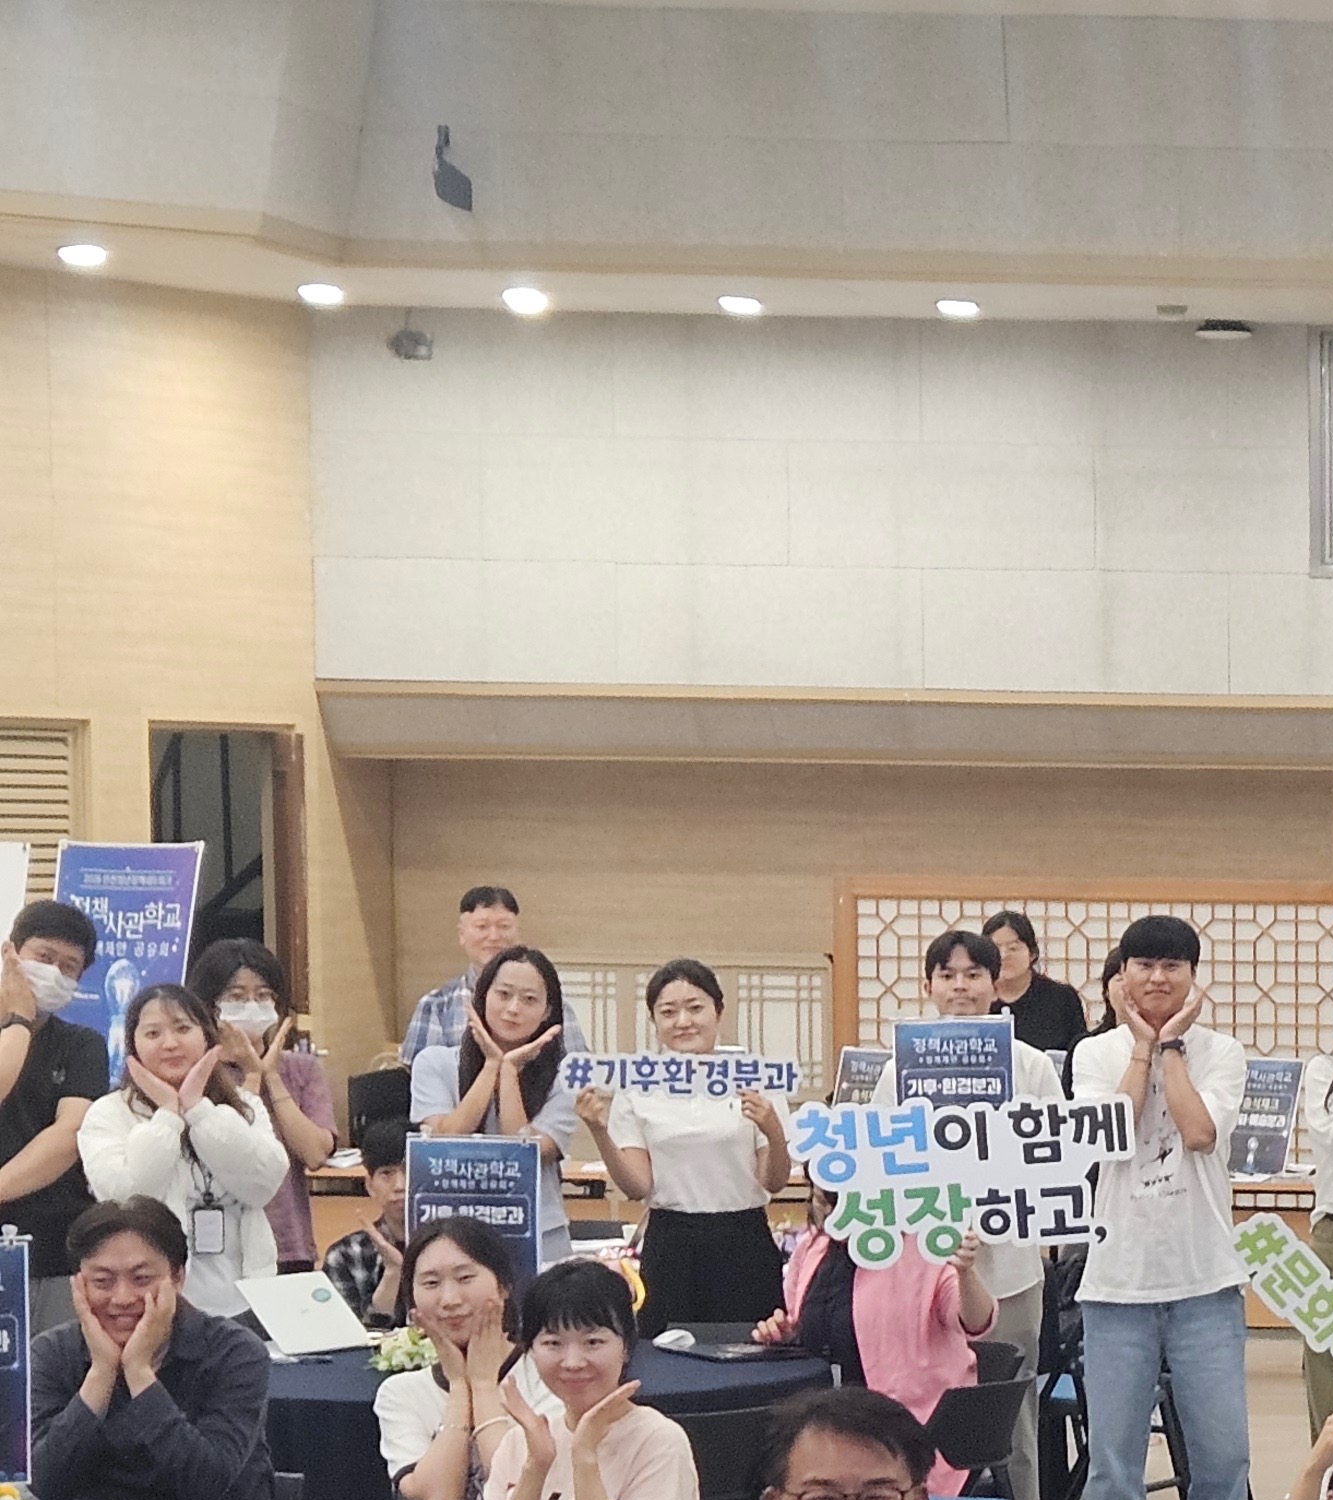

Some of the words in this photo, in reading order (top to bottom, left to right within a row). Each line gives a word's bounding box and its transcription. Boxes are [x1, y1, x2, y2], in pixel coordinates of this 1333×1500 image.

[565, 1054, 798, 1097] #기후환경분과
[795, 1104, 989, 1183] 청년이
[1007, 1102, 1128, 1165] 함께
[832, 1184, 1108, 1263] 성장하고,
